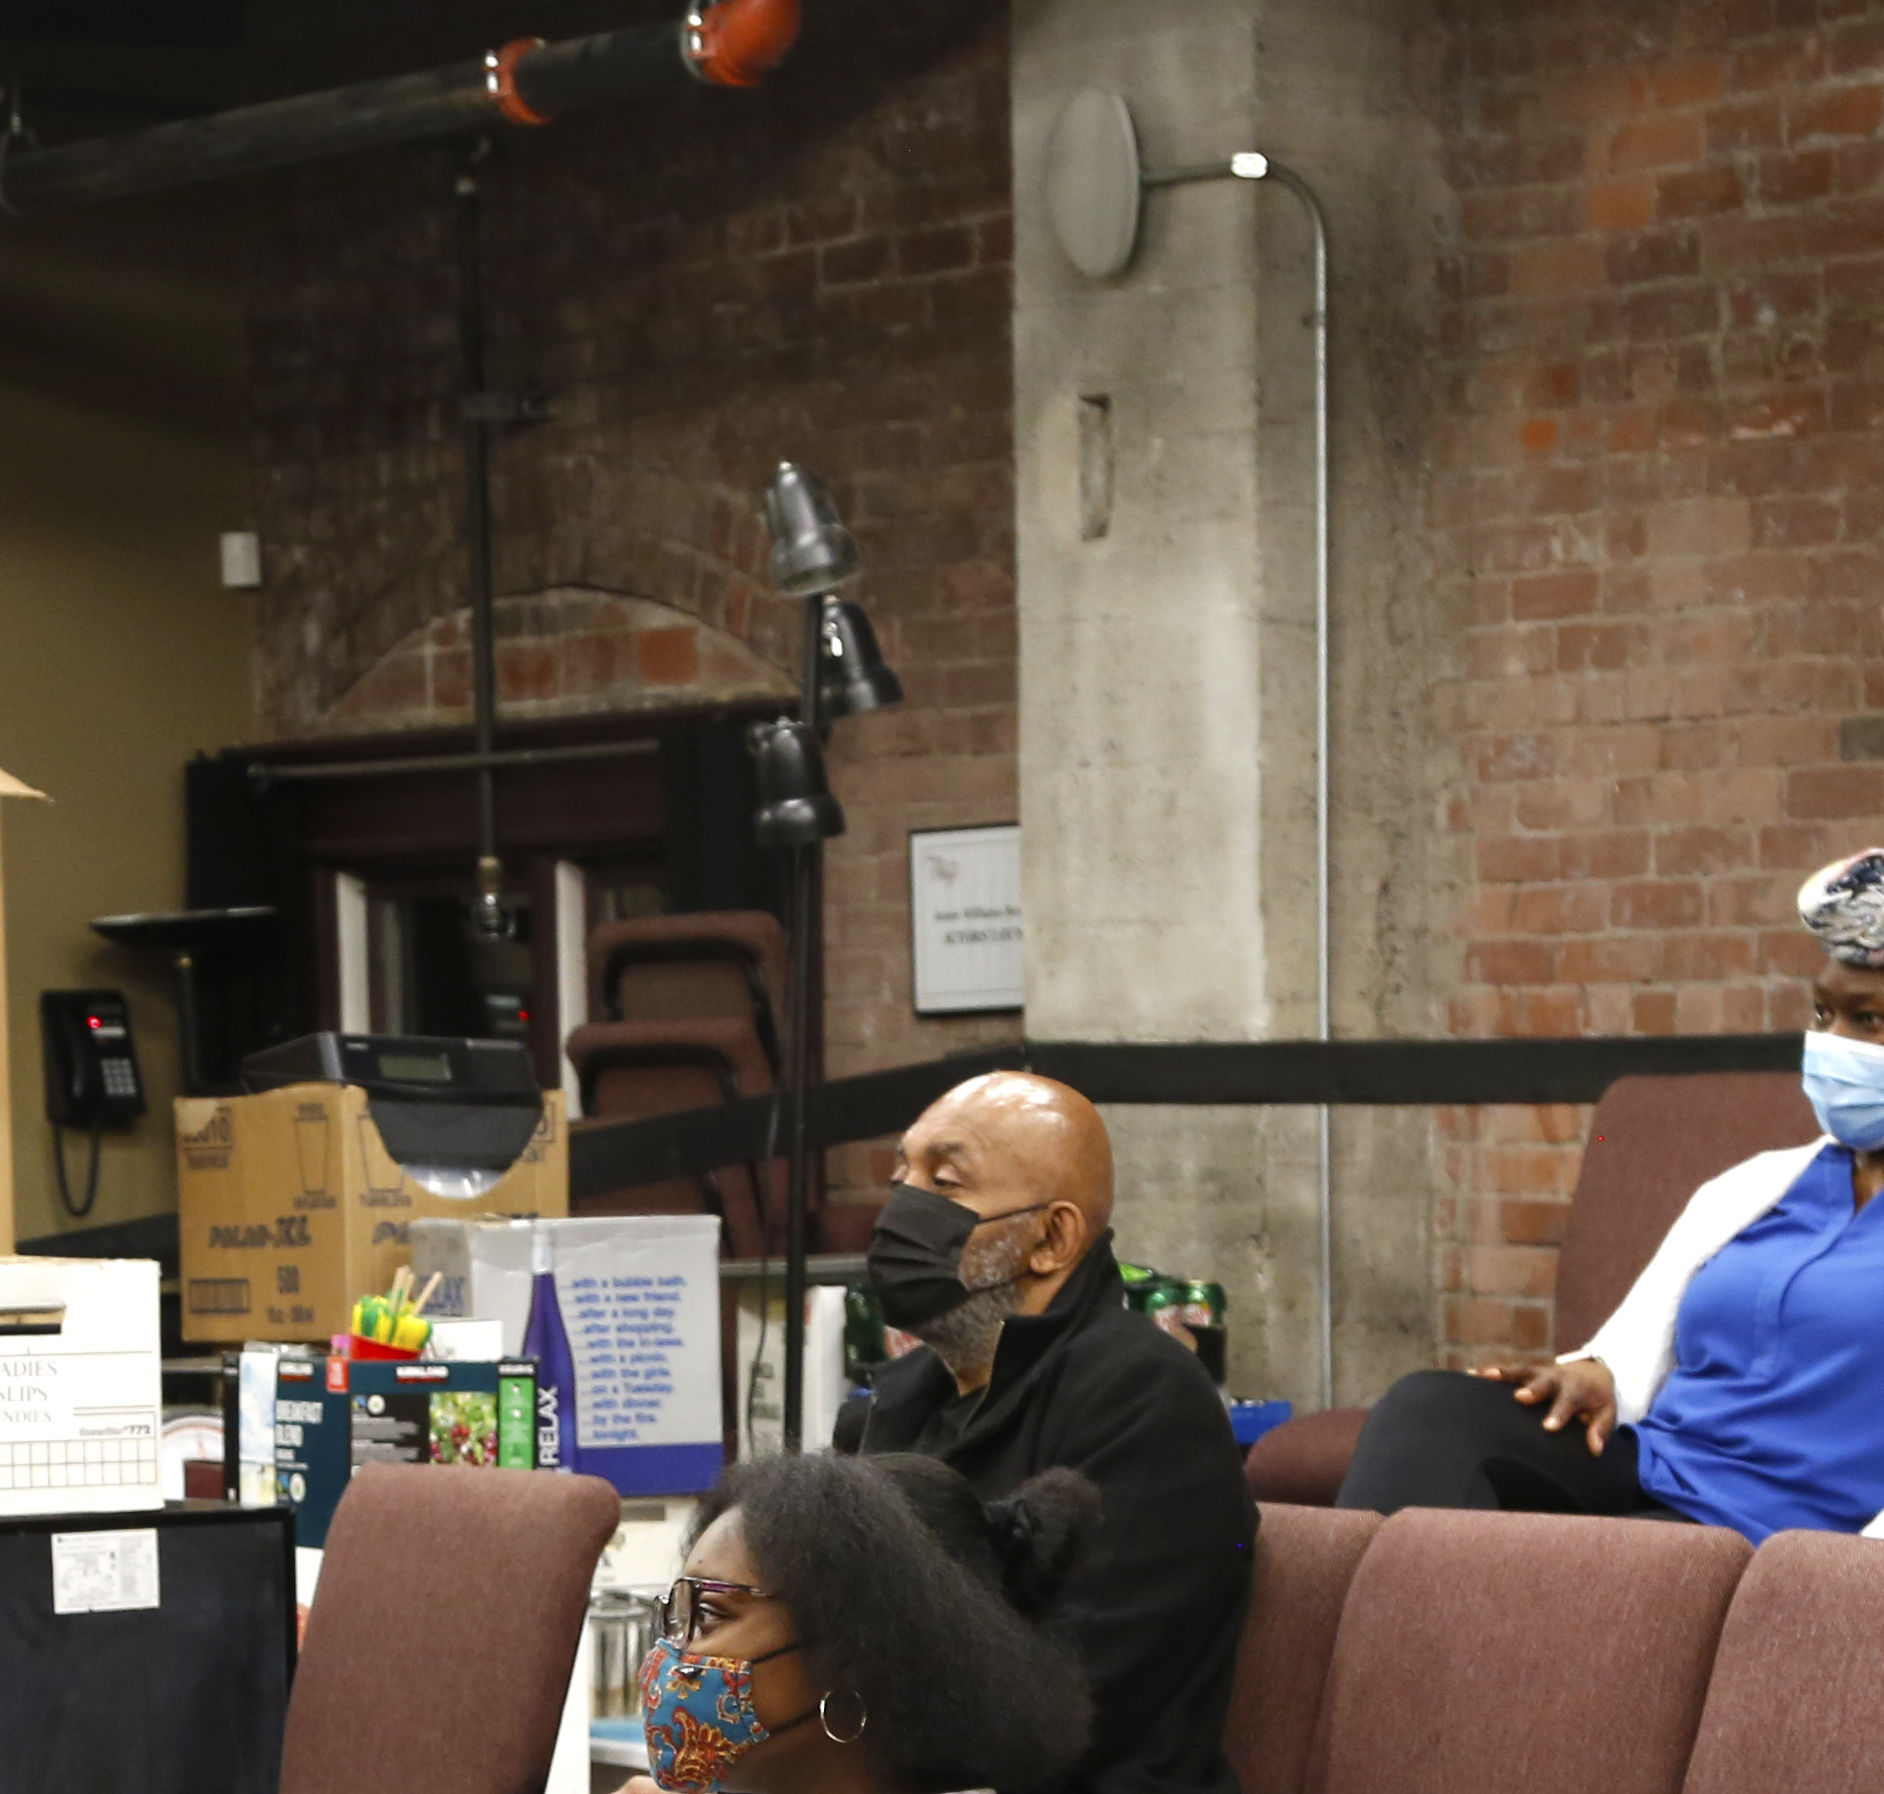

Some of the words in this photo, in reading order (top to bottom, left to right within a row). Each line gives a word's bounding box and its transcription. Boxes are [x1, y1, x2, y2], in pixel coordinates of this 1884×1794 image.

[612, 1276, 654, 1287] bubble
[622, 1308, 648, 1320] long
[616, 1337, 636, 1347] the
[620, 1368, 640, 1378] the
[612, 1413, 632, 1423] the
[537, 1385, 561, 1466] RELAX
